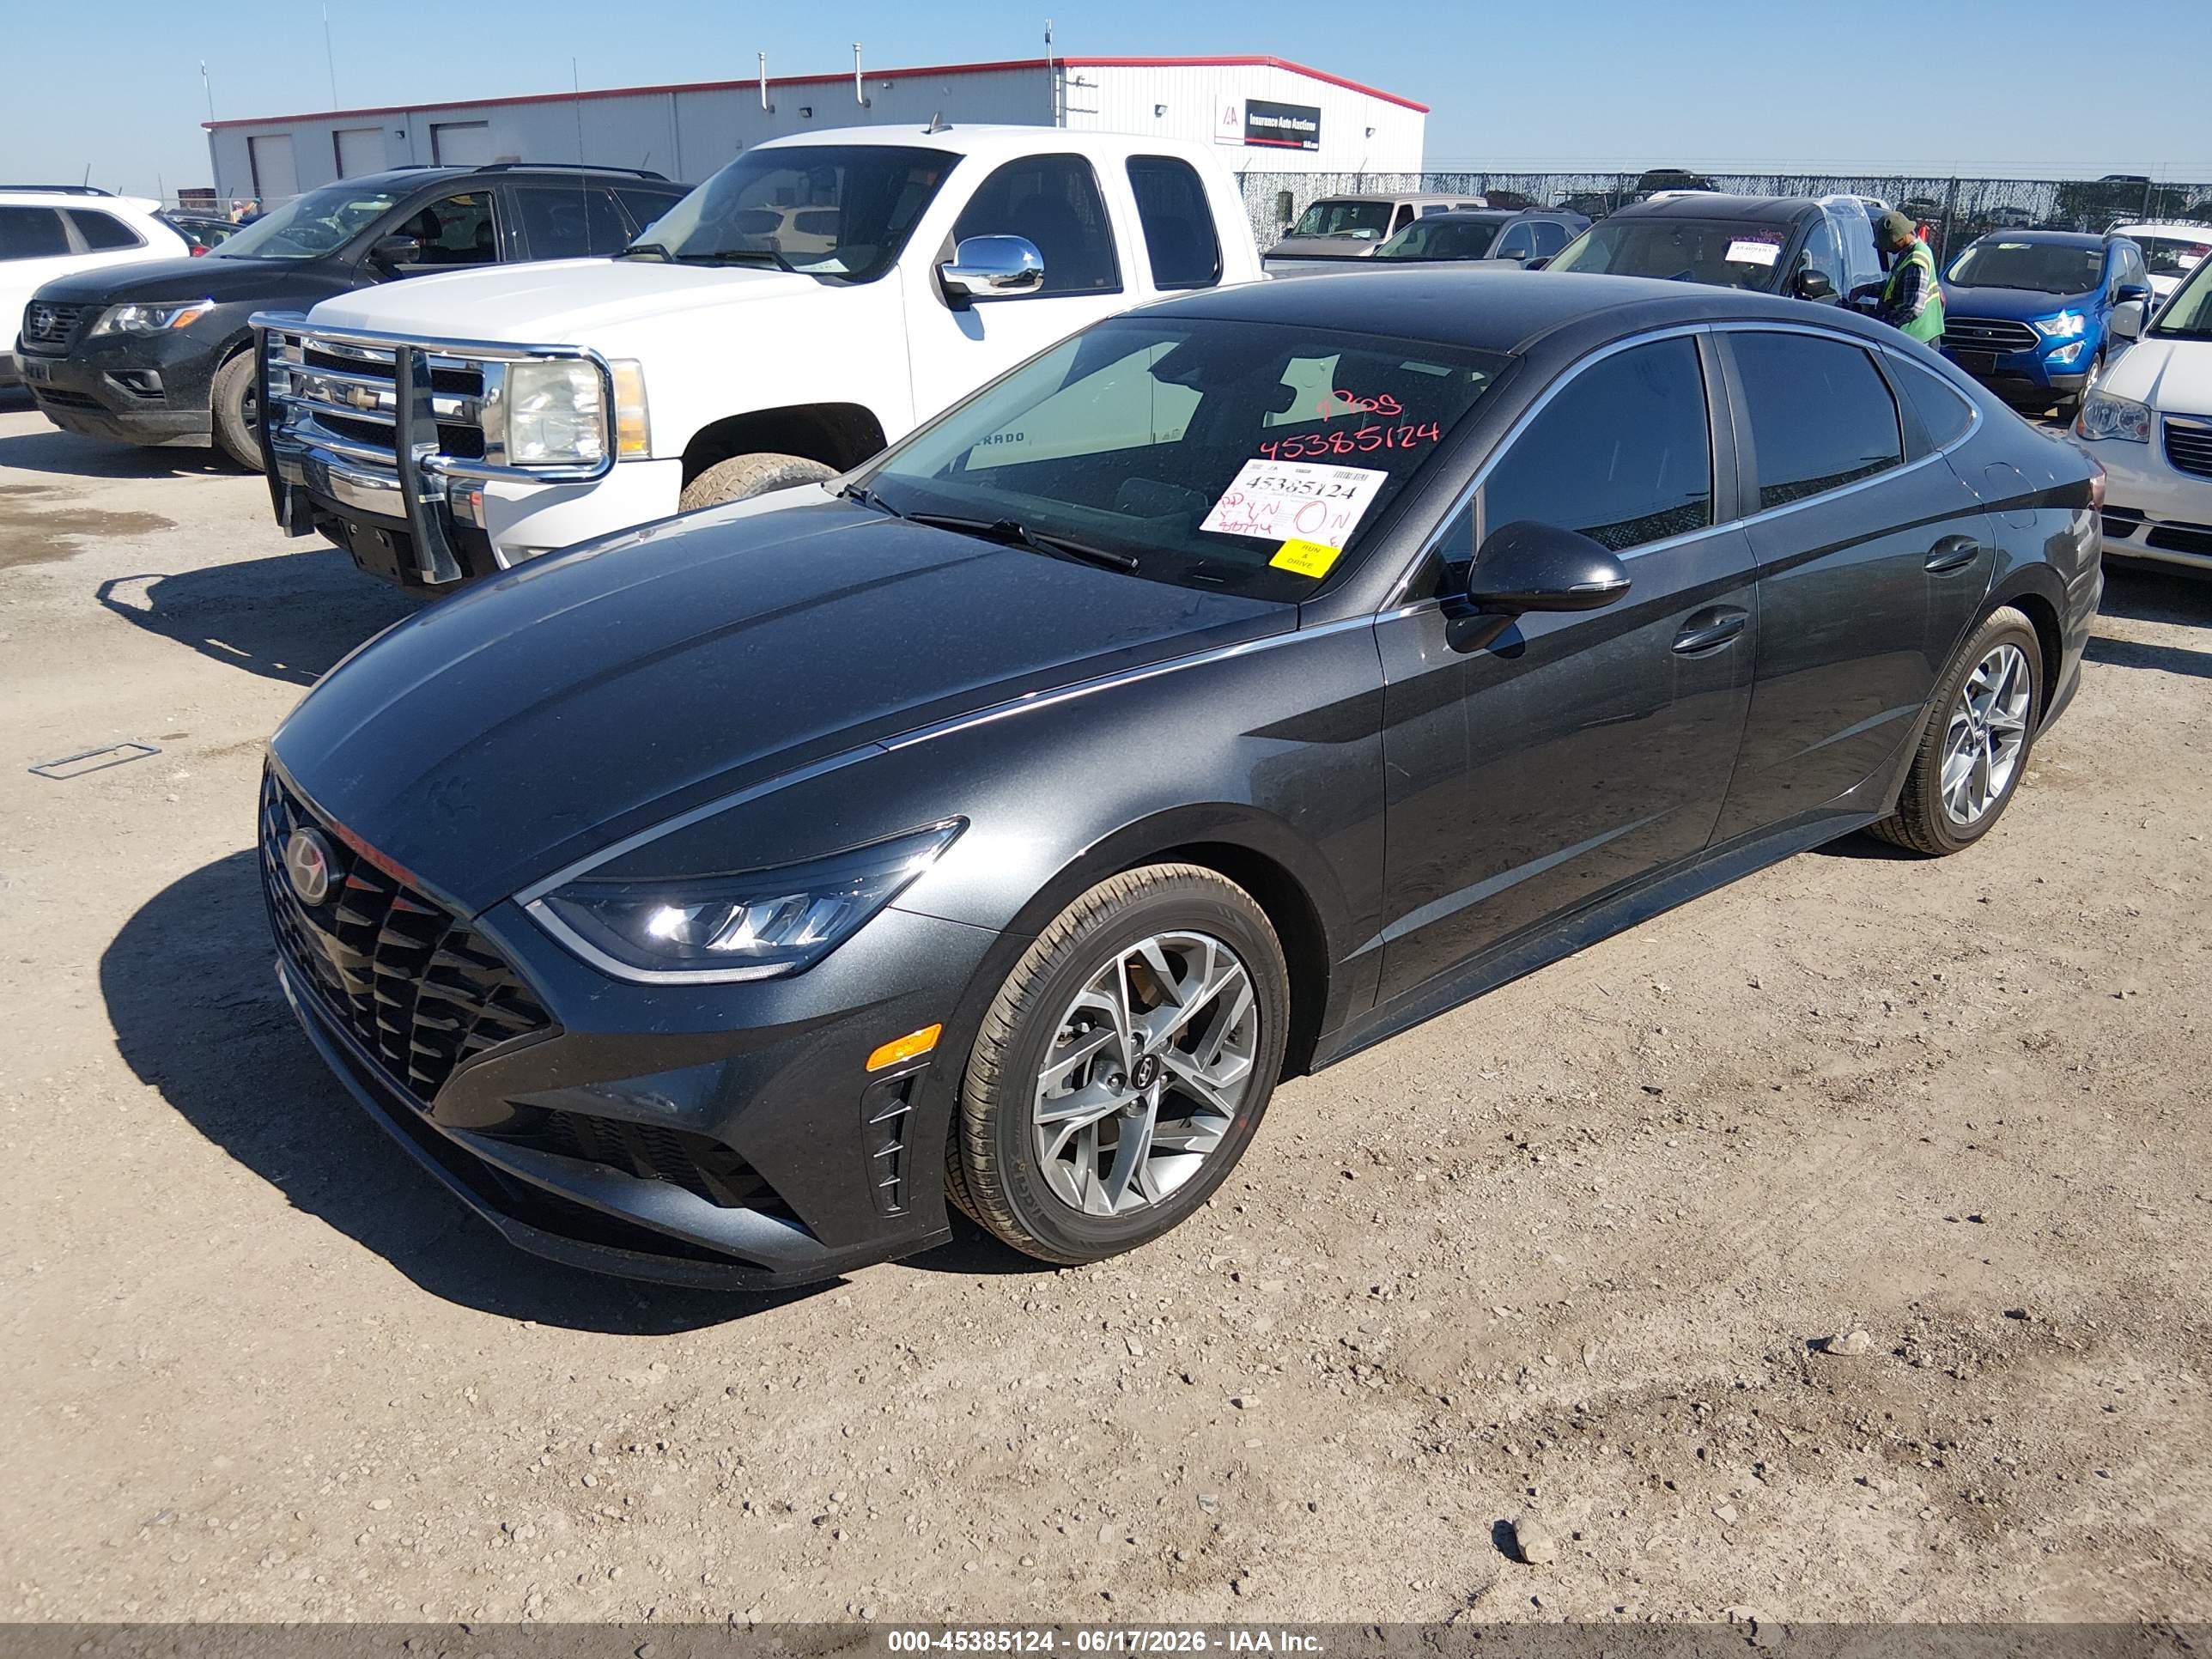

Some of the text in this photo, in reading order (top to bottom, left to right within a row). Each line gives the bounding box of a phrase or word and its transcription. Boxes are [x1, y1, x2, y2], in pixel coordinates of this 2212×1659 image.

[1249, 112, 1316, 131] Insurance Auto Auctions
[975, 432, 1025, 446] RADO
[1260, 421, 1440, 460] 45385124
[1246, 476, 1358, 500] 45385124
[1301, 544, 1322, 554] RUN
[1286, 557, 1315, 569] DRIVE
